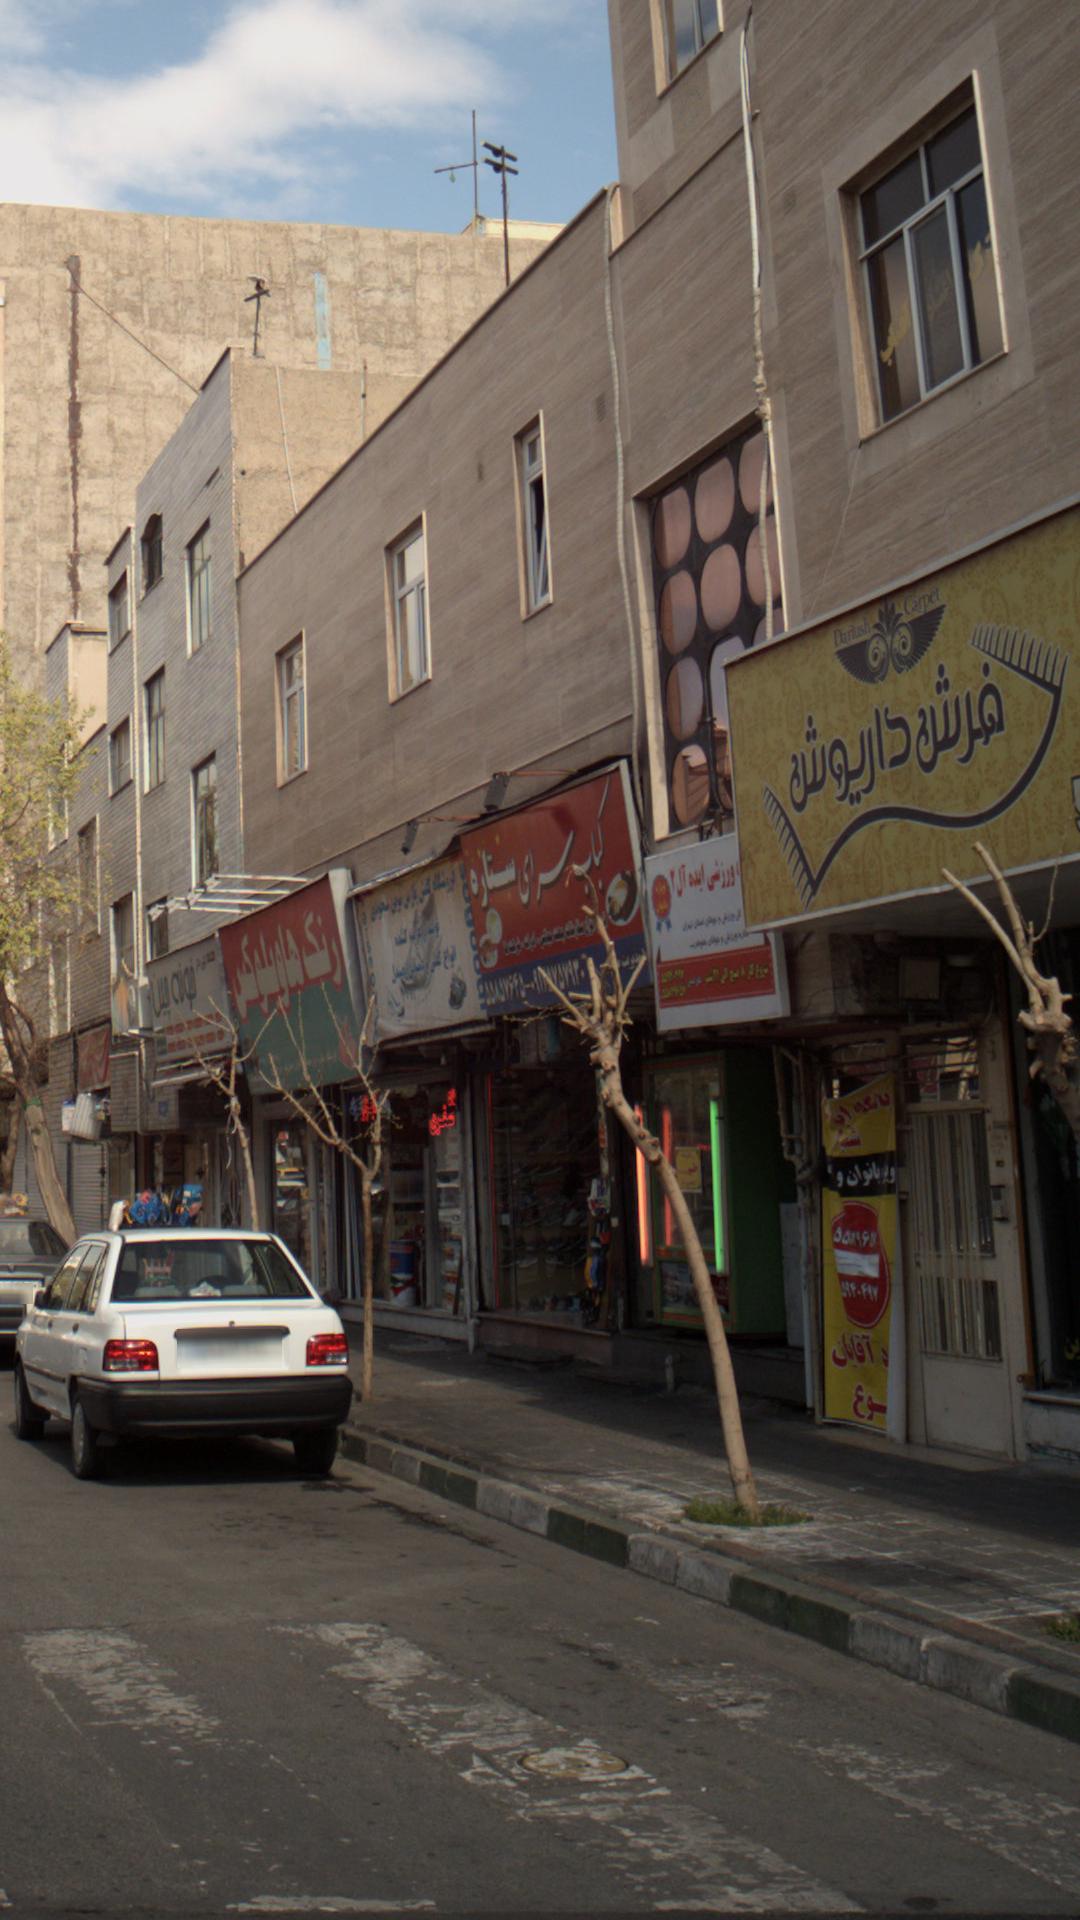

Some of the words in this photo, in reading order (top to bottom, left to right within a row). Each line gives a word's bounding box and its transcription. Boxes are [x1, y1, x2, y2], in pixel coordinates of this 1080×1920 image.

[903, 587, 941, 615] Carpet
[916, 662, 1005, 773] فرش
[790, 706, 911, 812] داریوش
[470, 849, 517, 909] ستاره
[302, 911, 342, 986] رنگ
[846, 1160, 881, 1187] بانوان
[832, 1331, 874, 1368] آقایان
